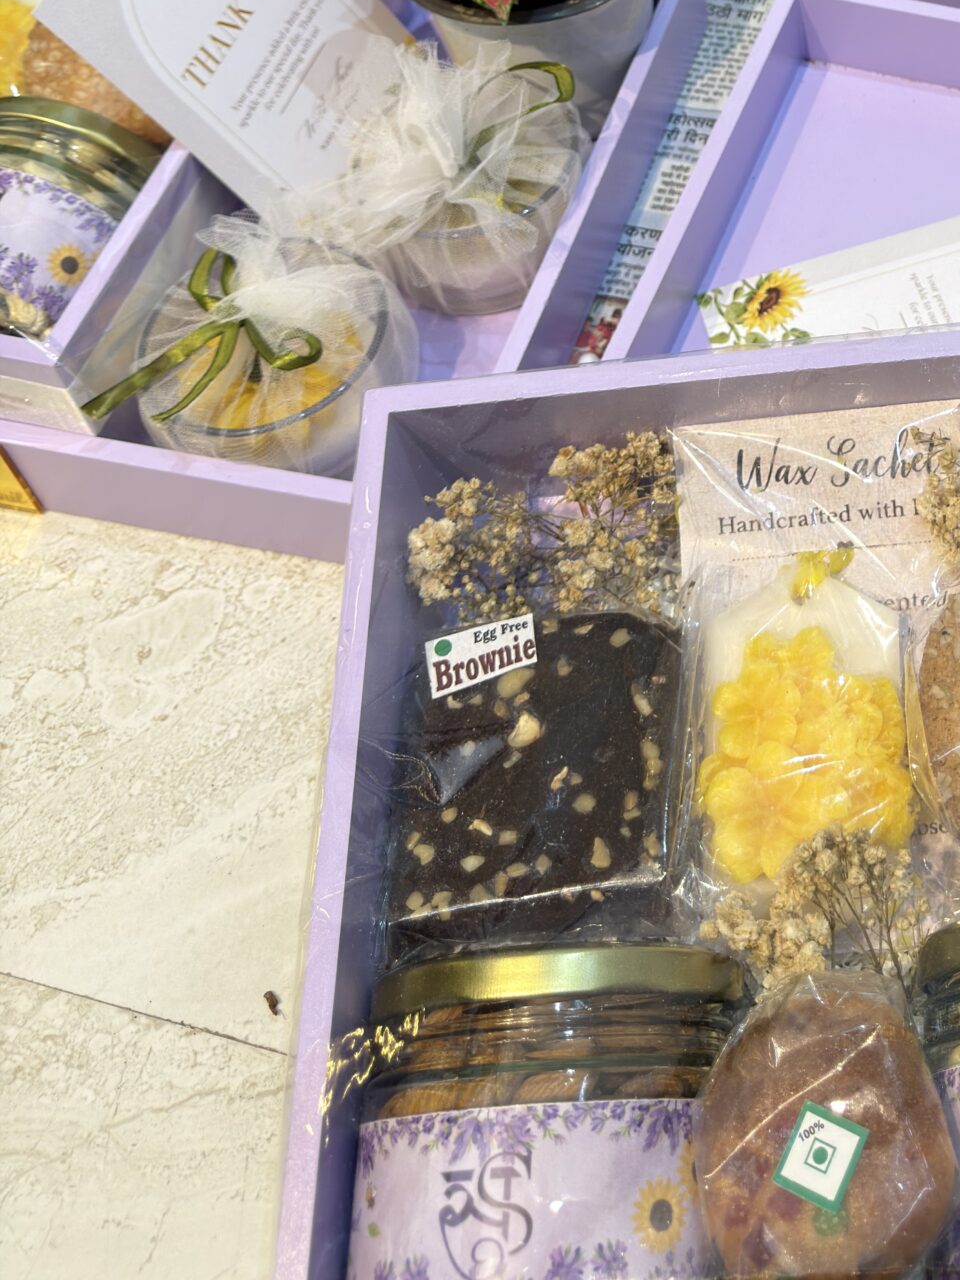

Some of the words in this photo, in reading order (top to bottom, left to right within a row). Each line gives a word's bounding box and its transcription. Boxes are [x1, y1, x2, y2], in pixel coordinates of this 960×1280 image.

[736, 437, 818, 494] Wax
[825, 428, 941, 488] Sachet
[717, 504, 852, 537] Handcrafted
[859, 499, 905, 520] with
[473, 628, 498, 644] Egg
[501, 620, 529, 636] Free
[433, 634, 537, 692] Brownie
[797, 1120, 825, 1143] 100%
